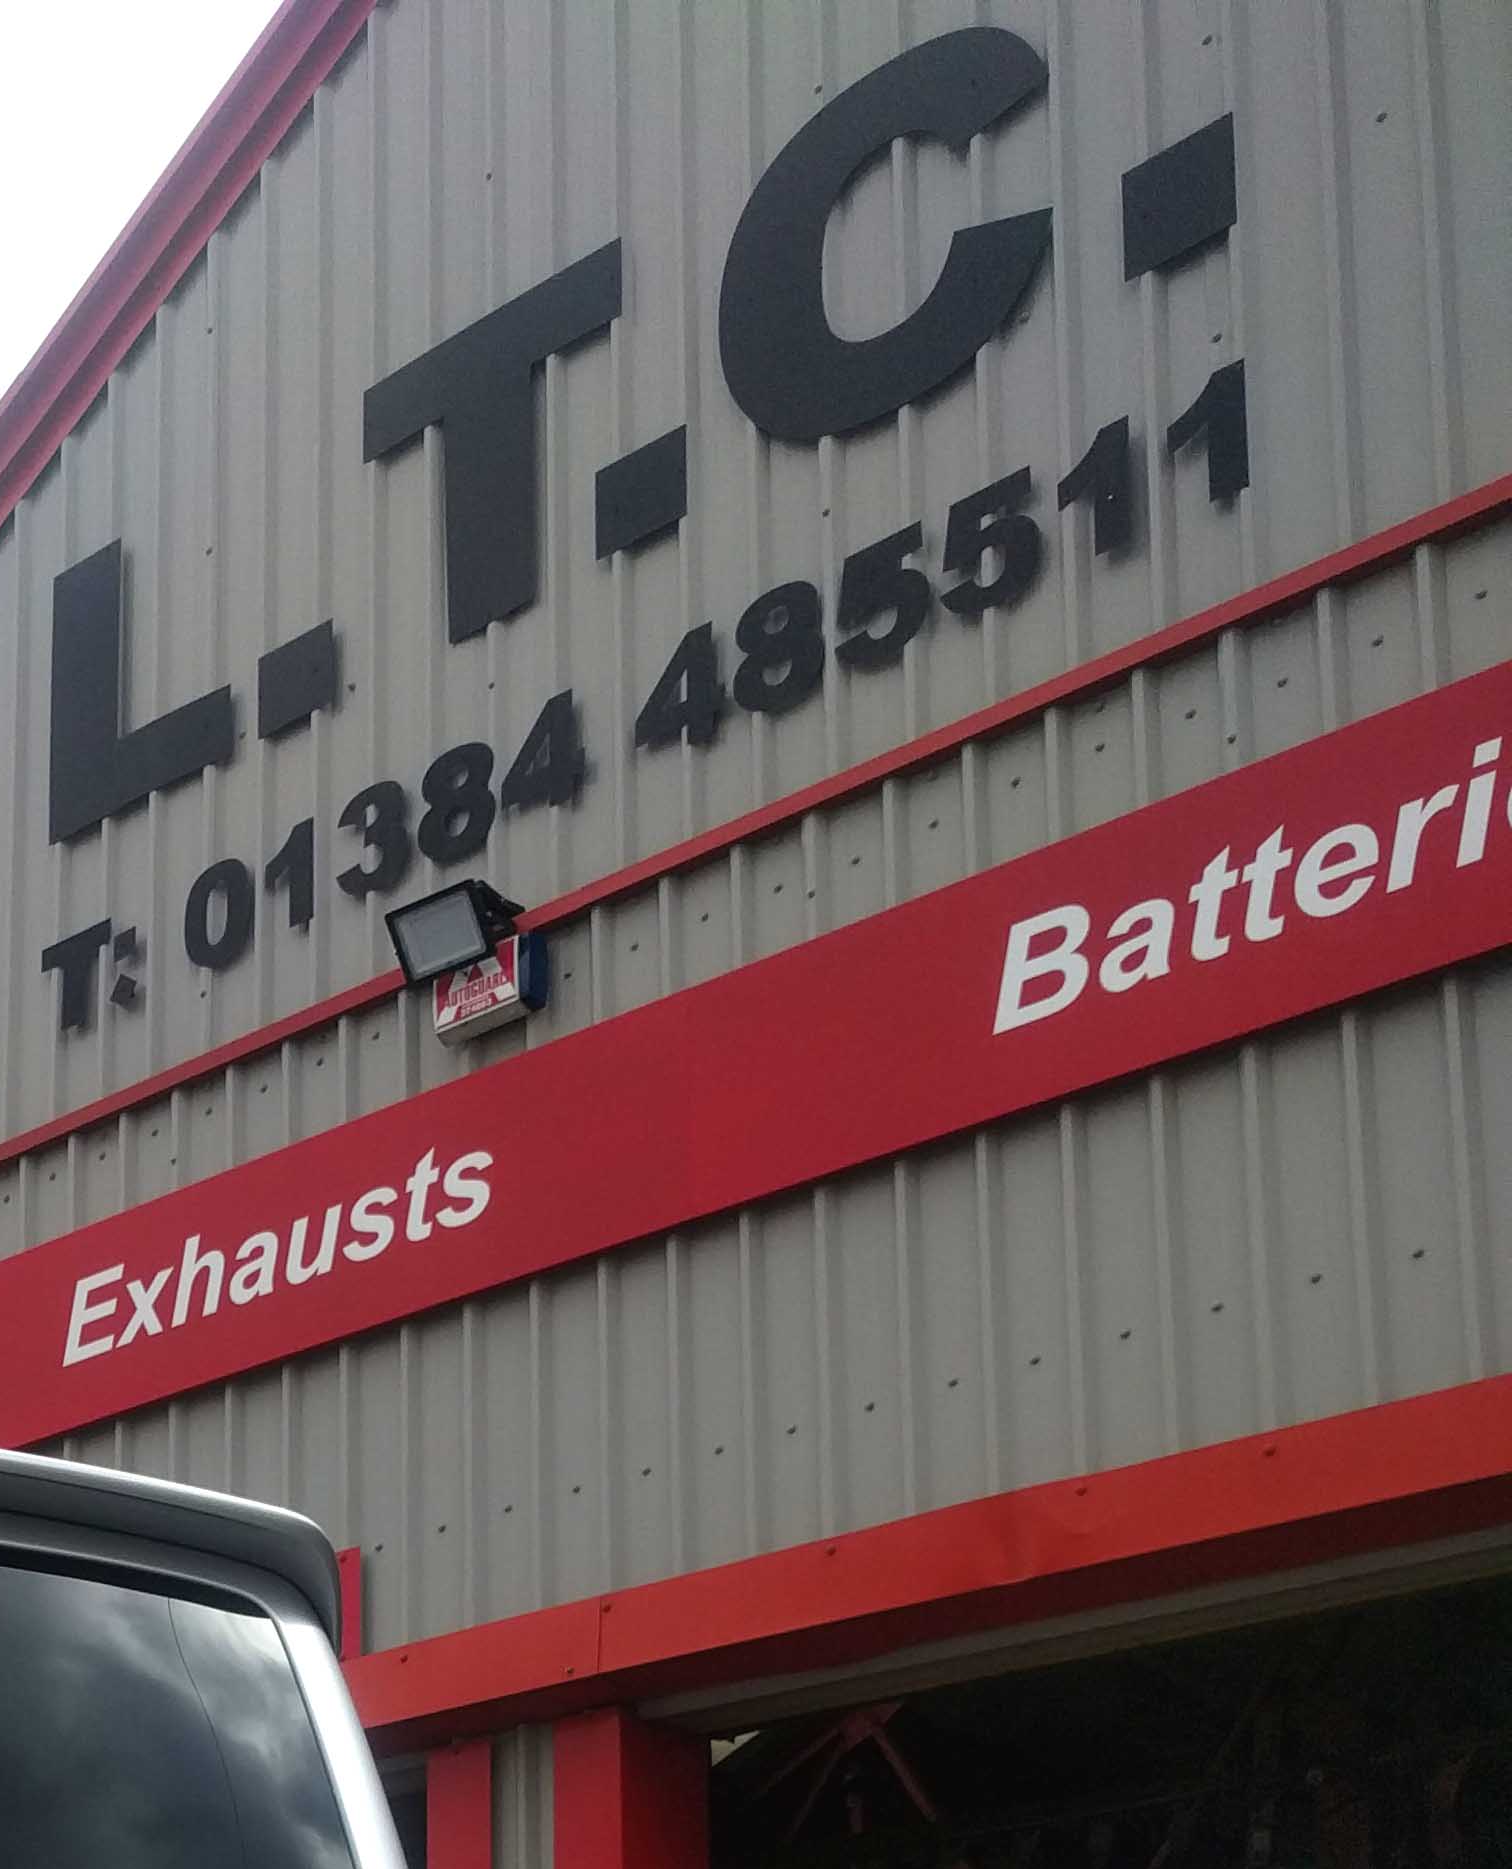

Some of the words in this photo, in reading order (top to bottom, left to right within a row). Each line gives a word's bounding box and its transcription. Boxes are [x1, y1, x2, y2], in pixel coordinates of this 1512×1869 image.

[41, 917, 137, 1030] T:
[184, 689, 584, 969] 01384
[634, 359, 1249, 748] 485511
[992, 736, 1512, 1036] Batteri
[63, 1147, 494, 1366] Exhausts
